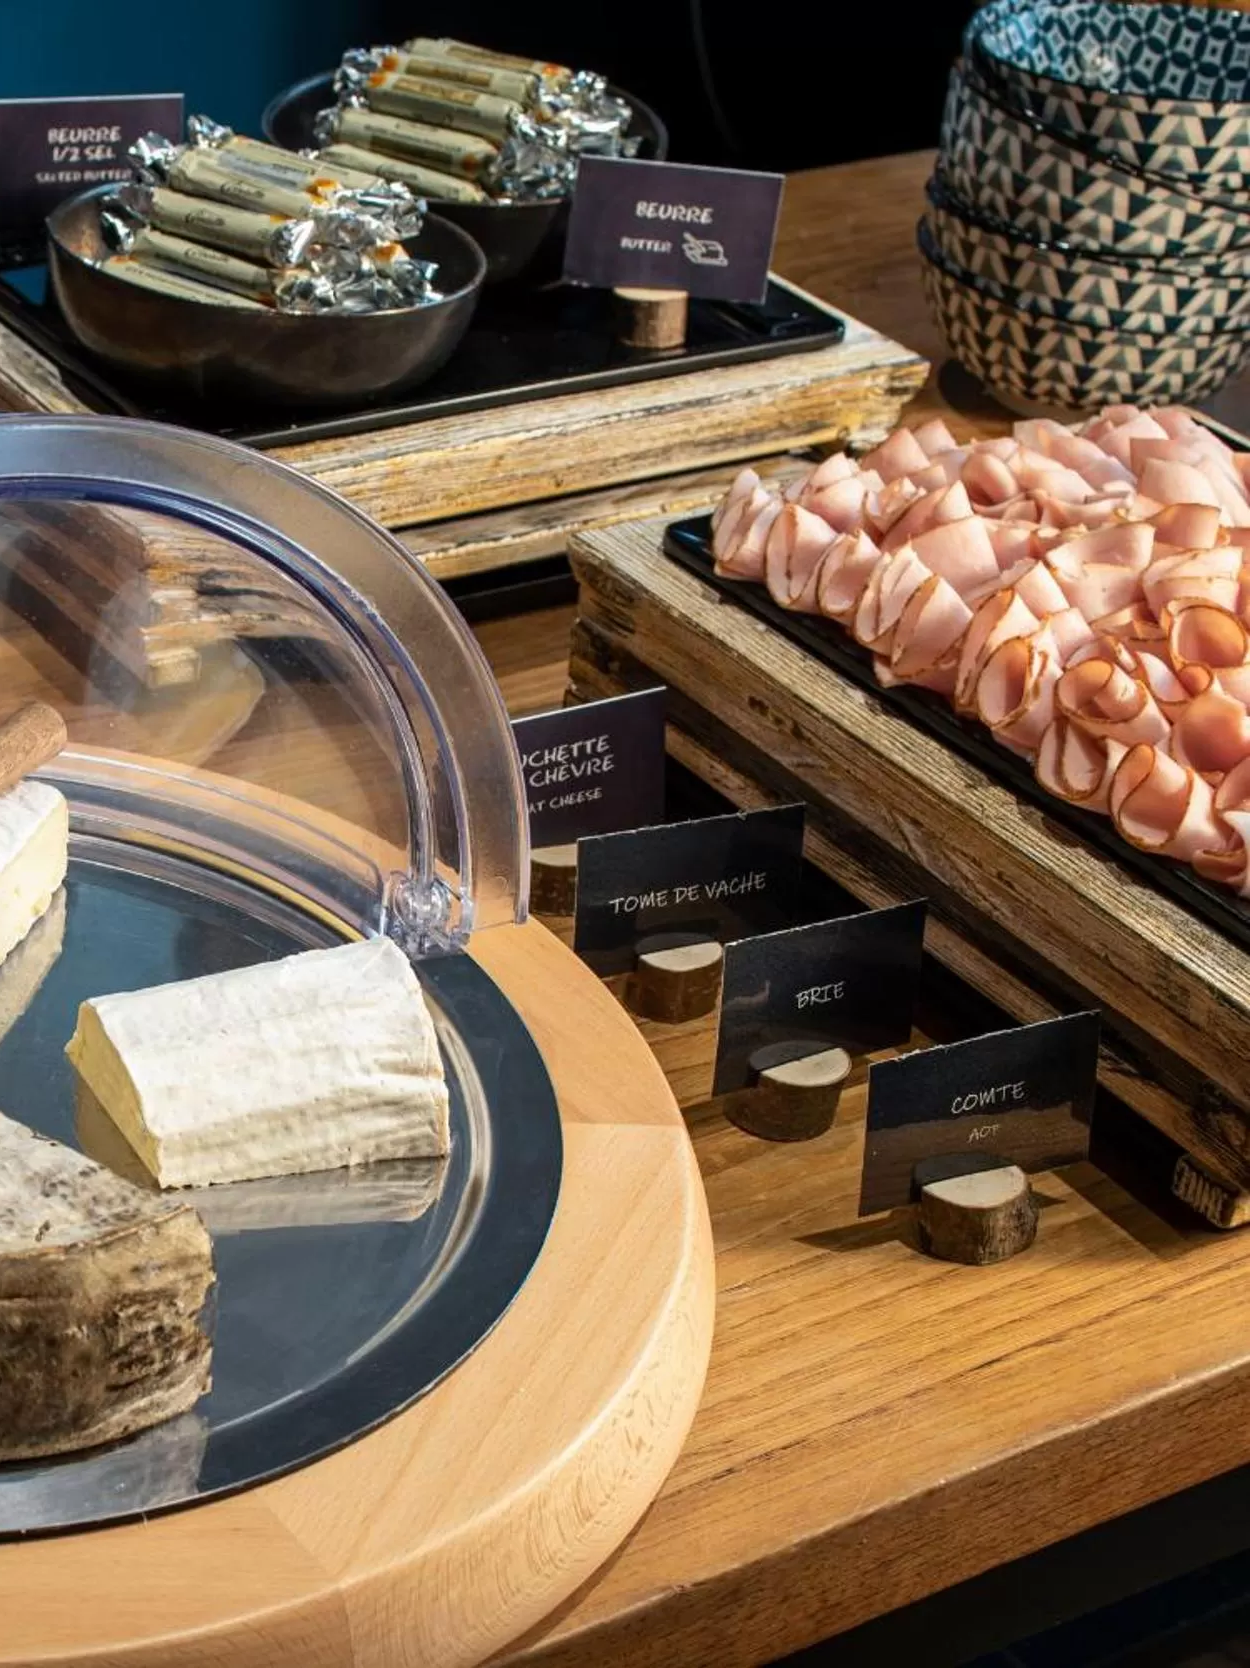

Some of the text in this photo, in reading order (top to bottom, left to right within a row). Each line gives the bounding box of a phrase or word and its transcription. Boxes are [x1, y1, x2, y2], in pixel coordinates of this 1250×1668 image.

[47, 126, 122, 143] BEURRE
[52, 146, 116, 162] 1/2 SEL
[635, 201, 713, 224] BEURRE
[620, 236, 672, 253] BUTTER
[549, 787, 602, 809] CHEESE
[609, 872, 767, 914] TOME DE VACHE
[795, 980, 846, 1009] BRIE
[951, 1080, 1026, 1115] COMTE
